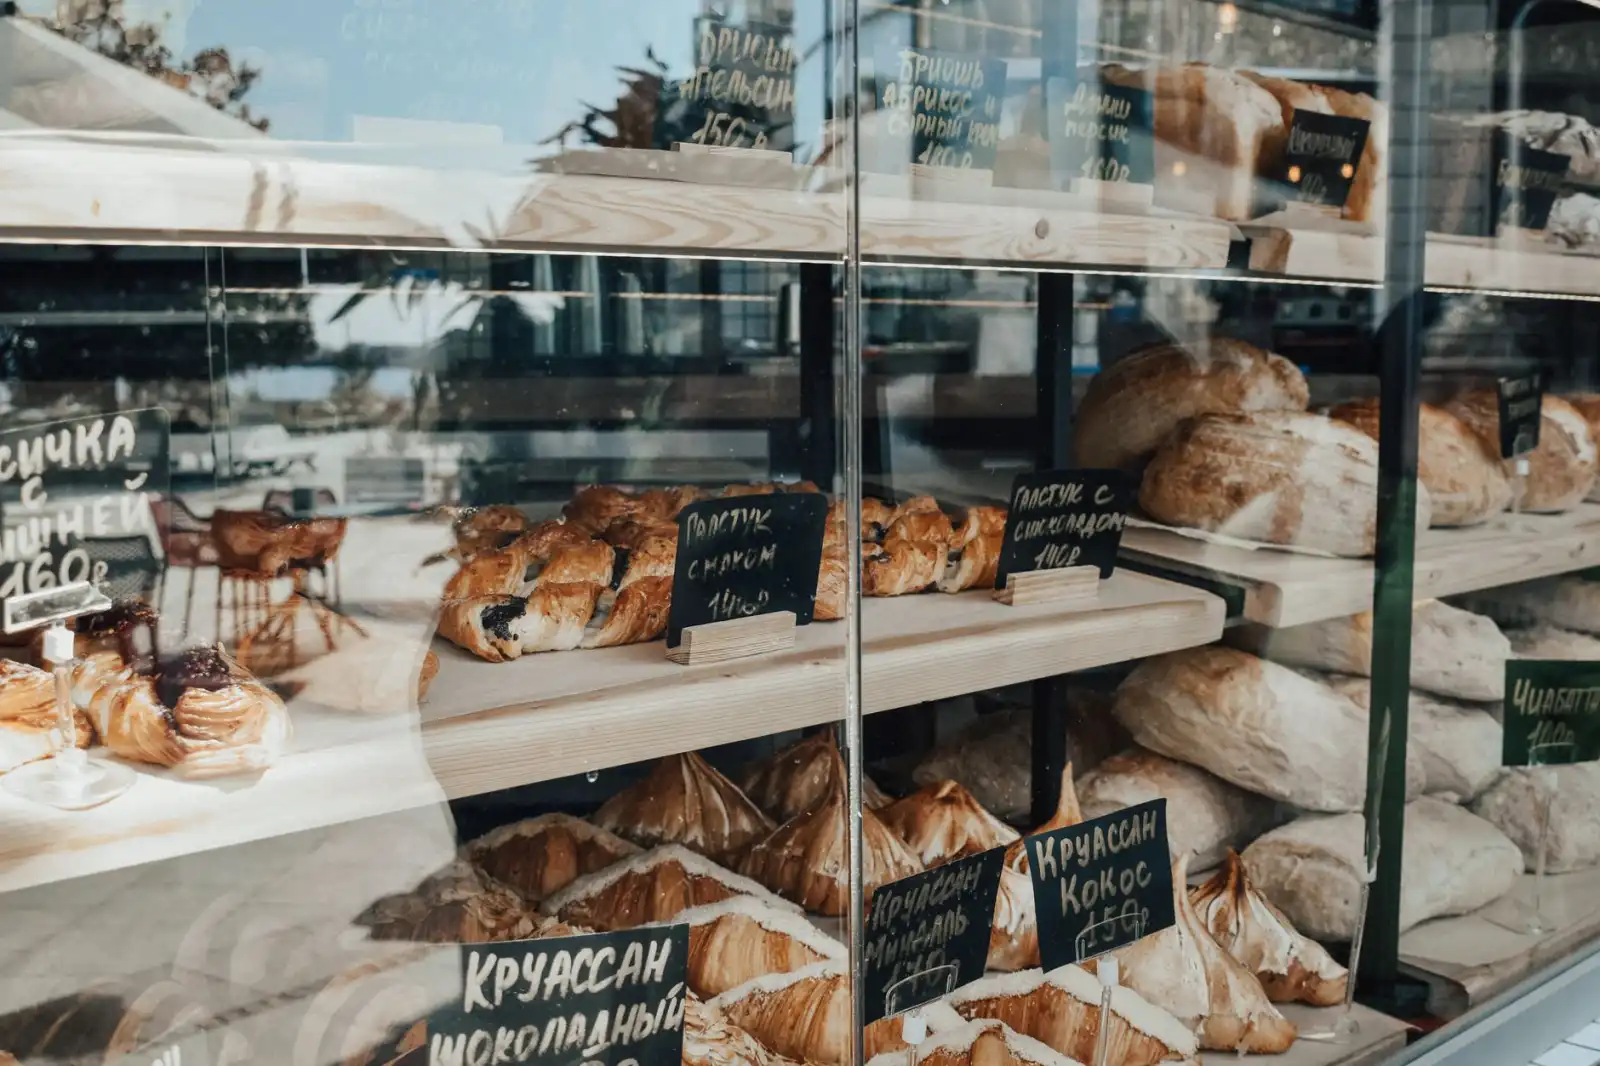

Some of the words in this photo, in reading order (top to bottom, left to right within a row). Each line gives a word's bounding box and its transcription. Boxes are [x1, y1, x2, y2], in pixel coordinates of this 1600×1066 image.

[1035, 810, 1157, 881] КРУАССАН
[1060, 861, 1152, 916] КОКОС
[464, 938, 672, 1013] КРУАССАН
[429, 982, 685, 1066] ШОКОЛАДНЫЙ
